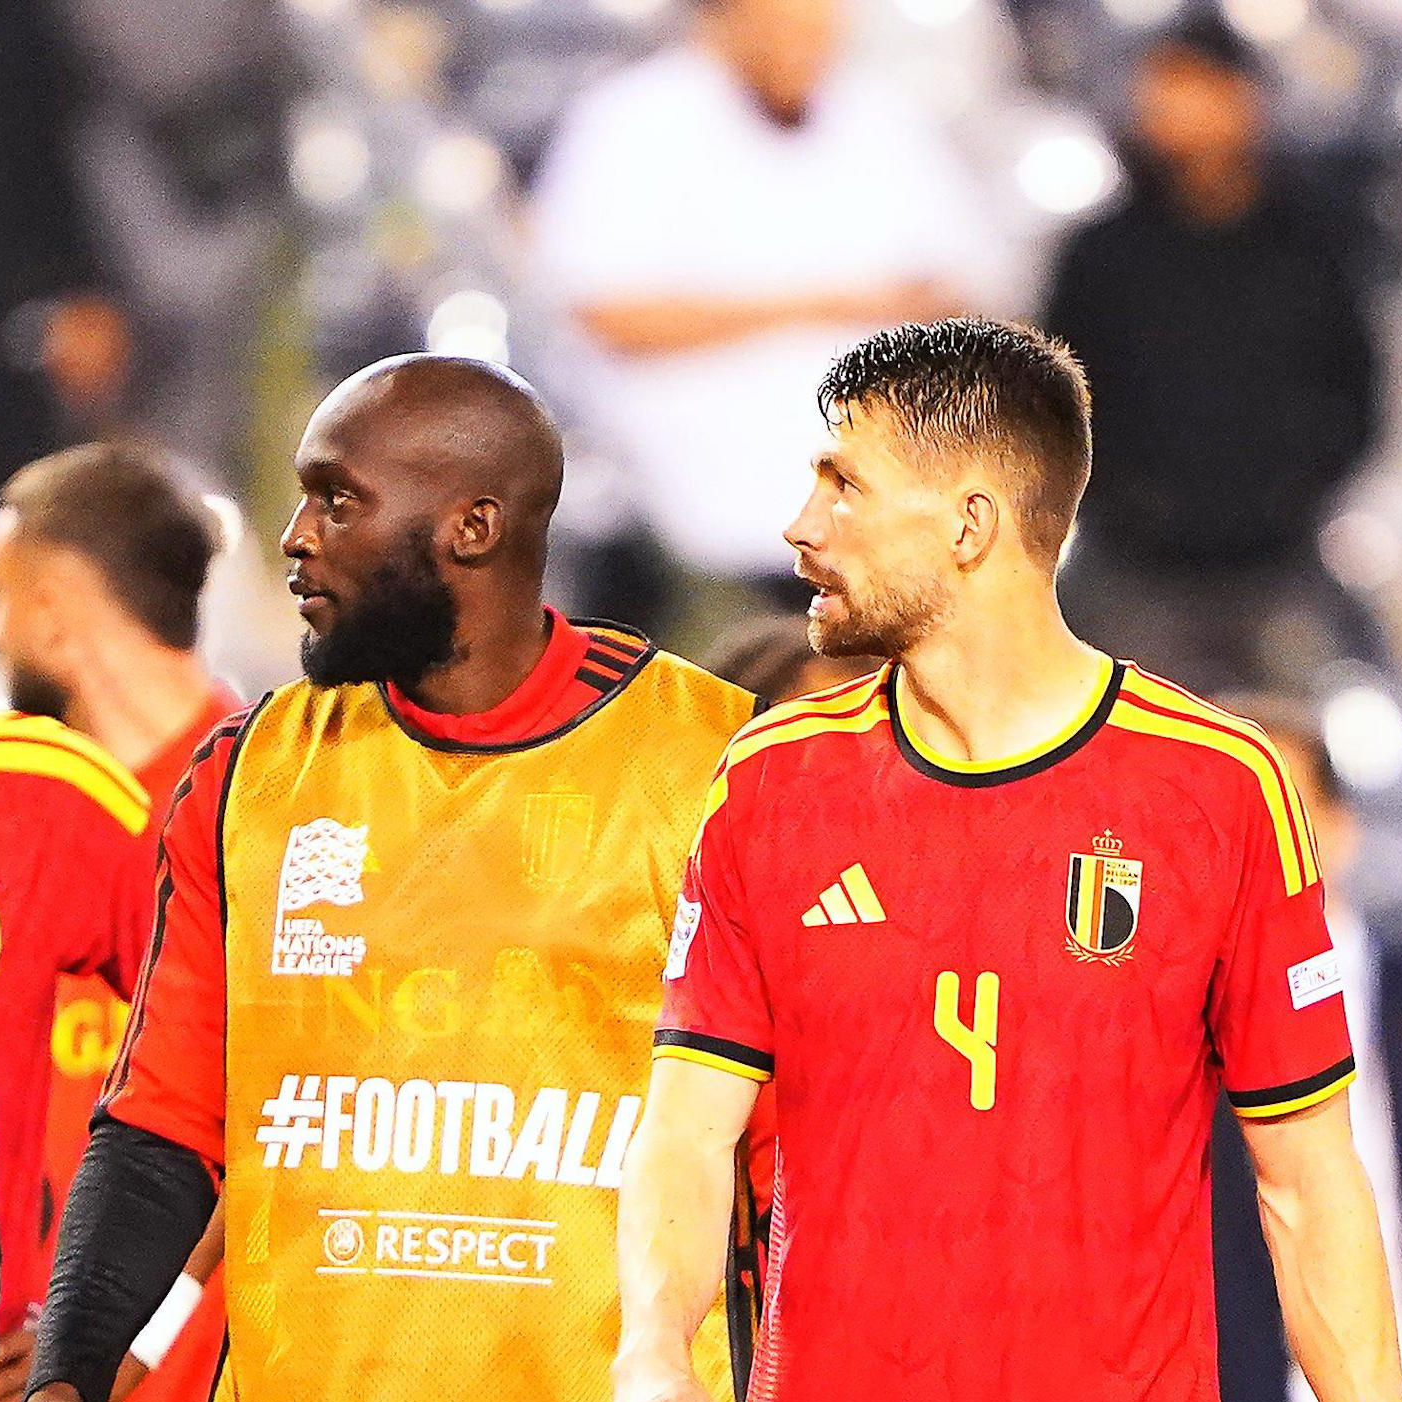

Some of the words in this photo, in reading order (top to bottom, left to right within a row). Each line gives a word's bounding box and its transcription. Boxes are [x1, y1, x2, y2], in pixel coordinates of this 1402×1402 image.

[284, 918, 325, 935] UEFA
[274, 934, 367, 956] NATIONS
[271, 953, 354, 977] LEAGUE
[933, 970, 1000, 1111] 4
[375, 1224, 556, 1272] RESPECT
